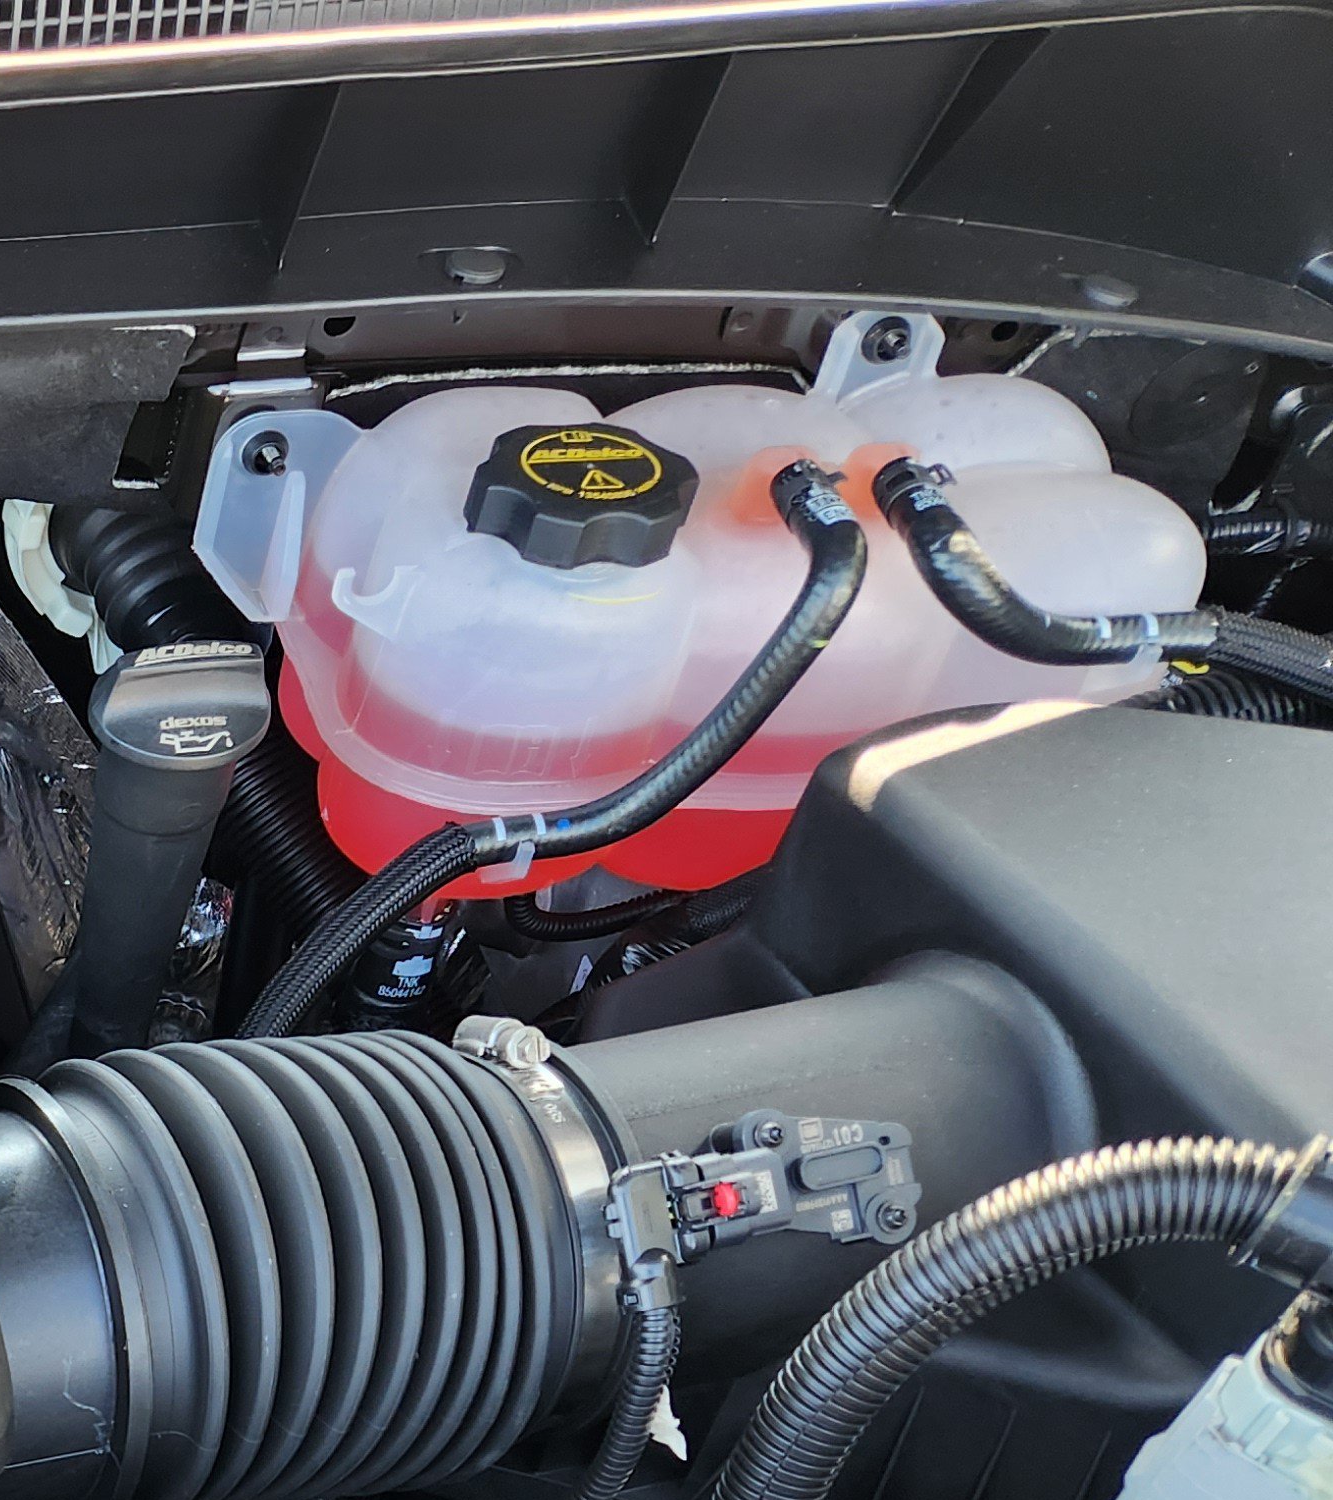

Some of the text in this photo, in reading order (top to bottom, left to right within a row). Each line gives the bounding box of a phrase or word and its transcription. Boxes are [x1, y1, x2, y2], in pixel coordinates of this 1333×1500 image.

[529, 446, 646, 463] ACDelco
[134, 641, 256, 666] ACDelco
[159, 714, 229, 731] dexos
